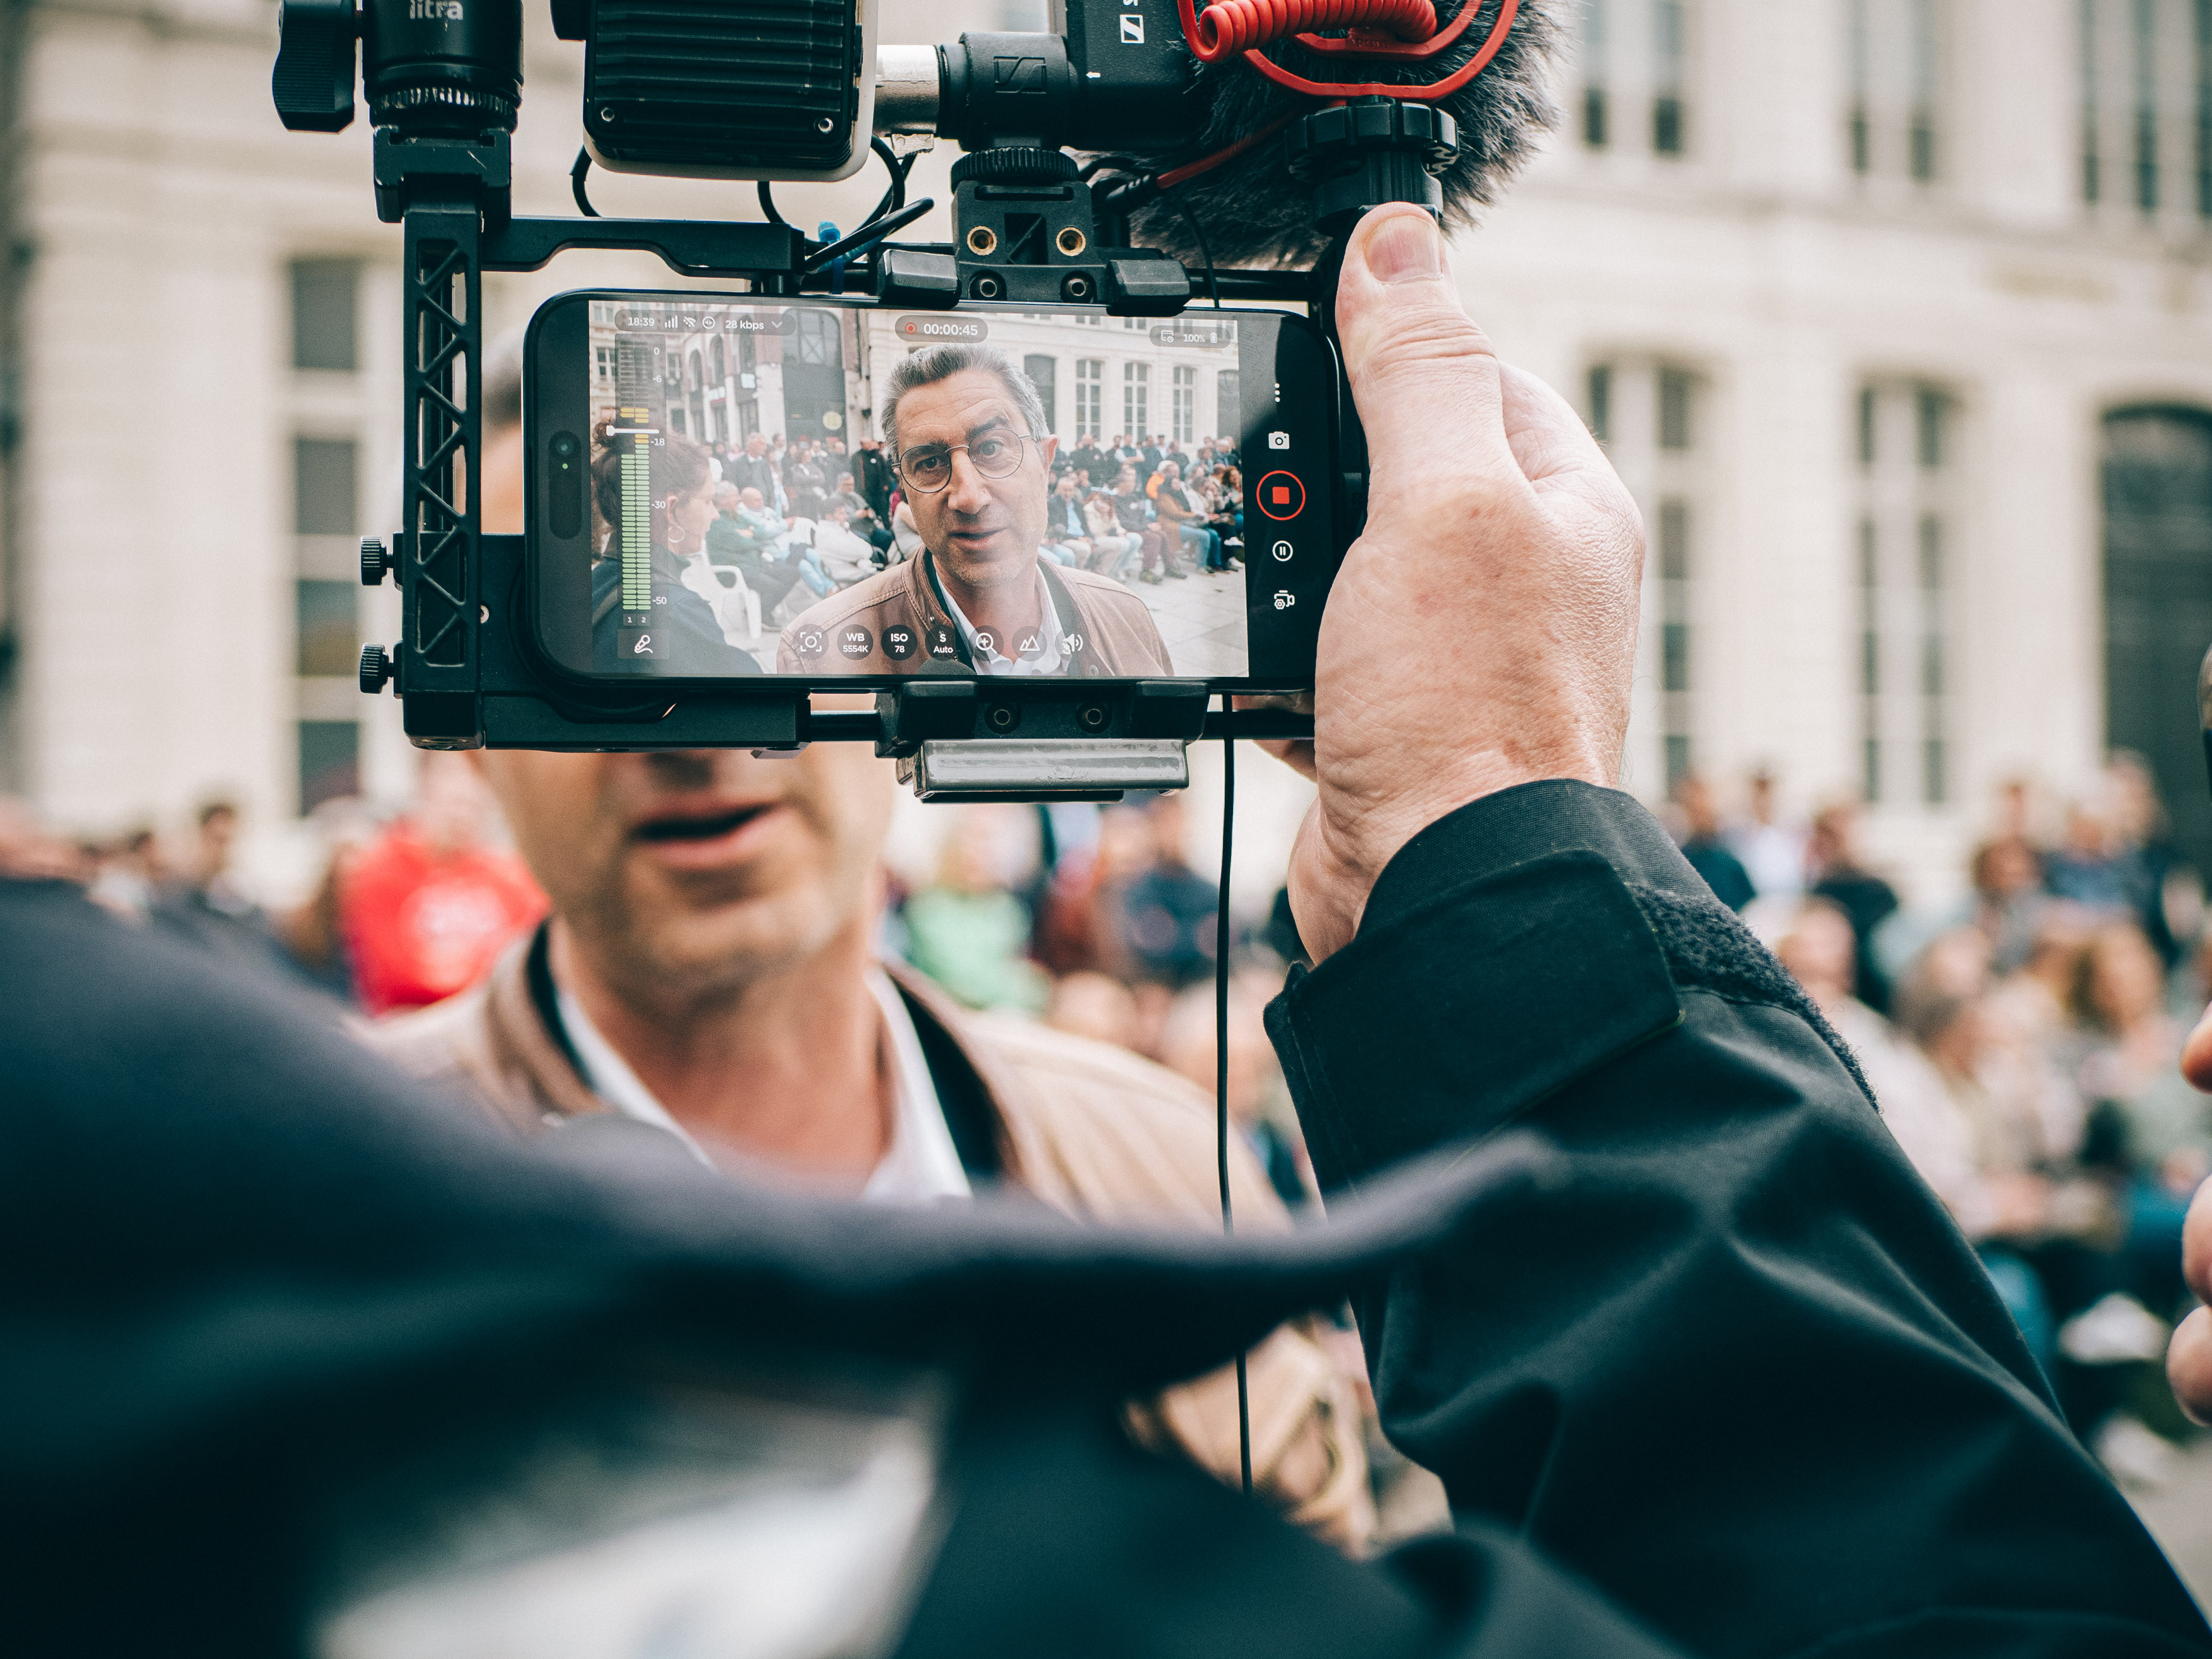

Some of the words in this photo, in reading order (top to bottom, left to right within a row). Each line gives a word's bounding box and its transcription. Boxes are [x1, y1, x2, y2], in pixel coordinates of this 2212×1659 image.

[410, 0, 463, 20] litra
[628, 317, 655, 327] 18:39
[726, 320, 738, 329] 28
[739, 320, 765, 331] kbps
[923, 323, 978, 336] 00:00:45
[1182, 334, 1206, 343] 100%
[653, 347, 660, 355] 0
[653, 375, 662, 383] -6
[650, 438, 665, 446] -18
[651, 501, 666, 509] -30
[652, 597, 667, 605] -50
[846, 633, 865, 642] WB
[890, 633, 909, 642] ISO
[939, 634, 947, 643] S
[842, 645, 869, 653] 5554K
[933, 645, 954, 653] Auto
